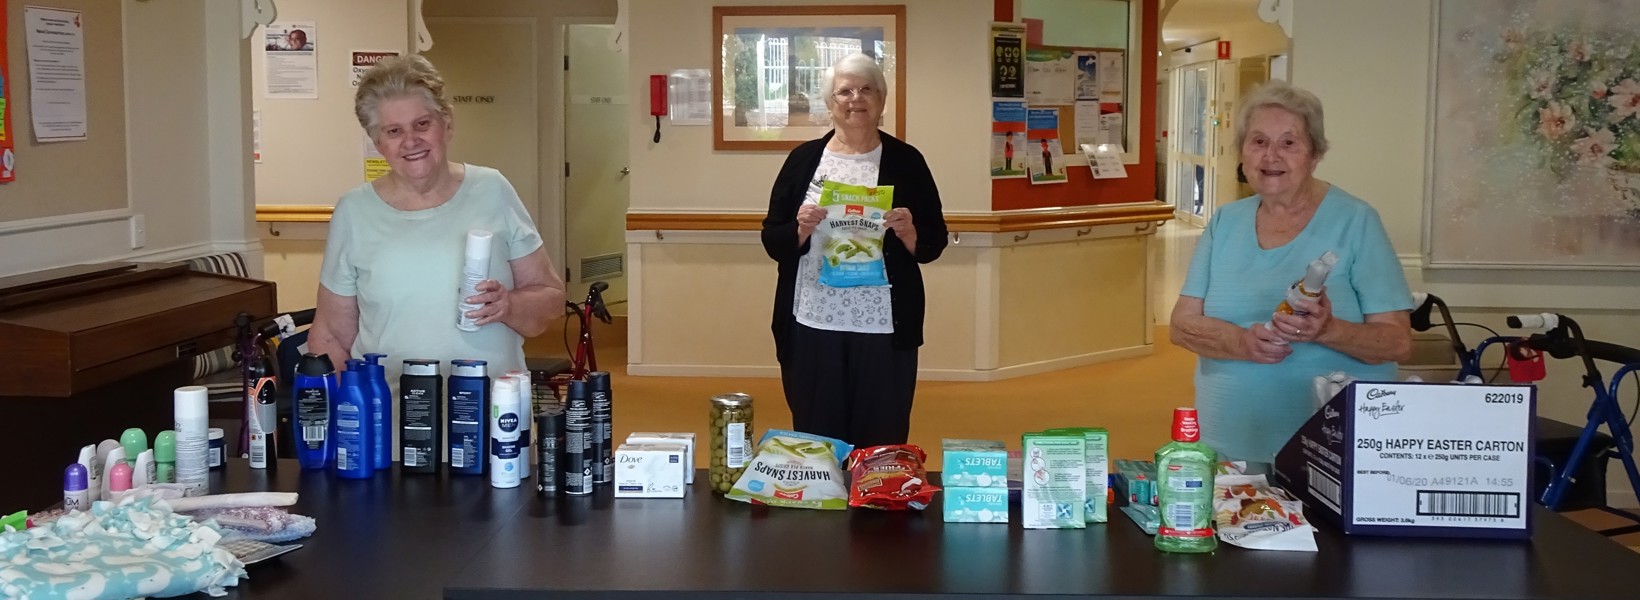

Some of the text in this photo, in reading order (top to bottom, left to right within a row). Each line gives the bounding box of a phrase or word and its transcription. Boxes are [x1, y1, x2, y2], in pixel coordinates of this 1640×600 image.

[832, 190, 840, 202] 5
[829, 219, 858, 229] HARVEST
[859, 218, 880, 231] SNAPS
[1485, 393, 1524, 404] 622019
[1358, 400, 1406, 420] Happy Easter
[1357, 438, 1524, 452] 250g HAPPY EASTER CARTON
[619, 453, 643, 463] Dove
[965, 457, 1002, 466] TABLETS
[1379, 452, 1414, 460] CONTENTS:
[1435, 453, 1449, 461] 250g
[754, 461, 831, 481] HARVEST SNAPS
[1431, 475, 1479, 486] A49121A
[966, 494, 1003, 502] TABLETS
